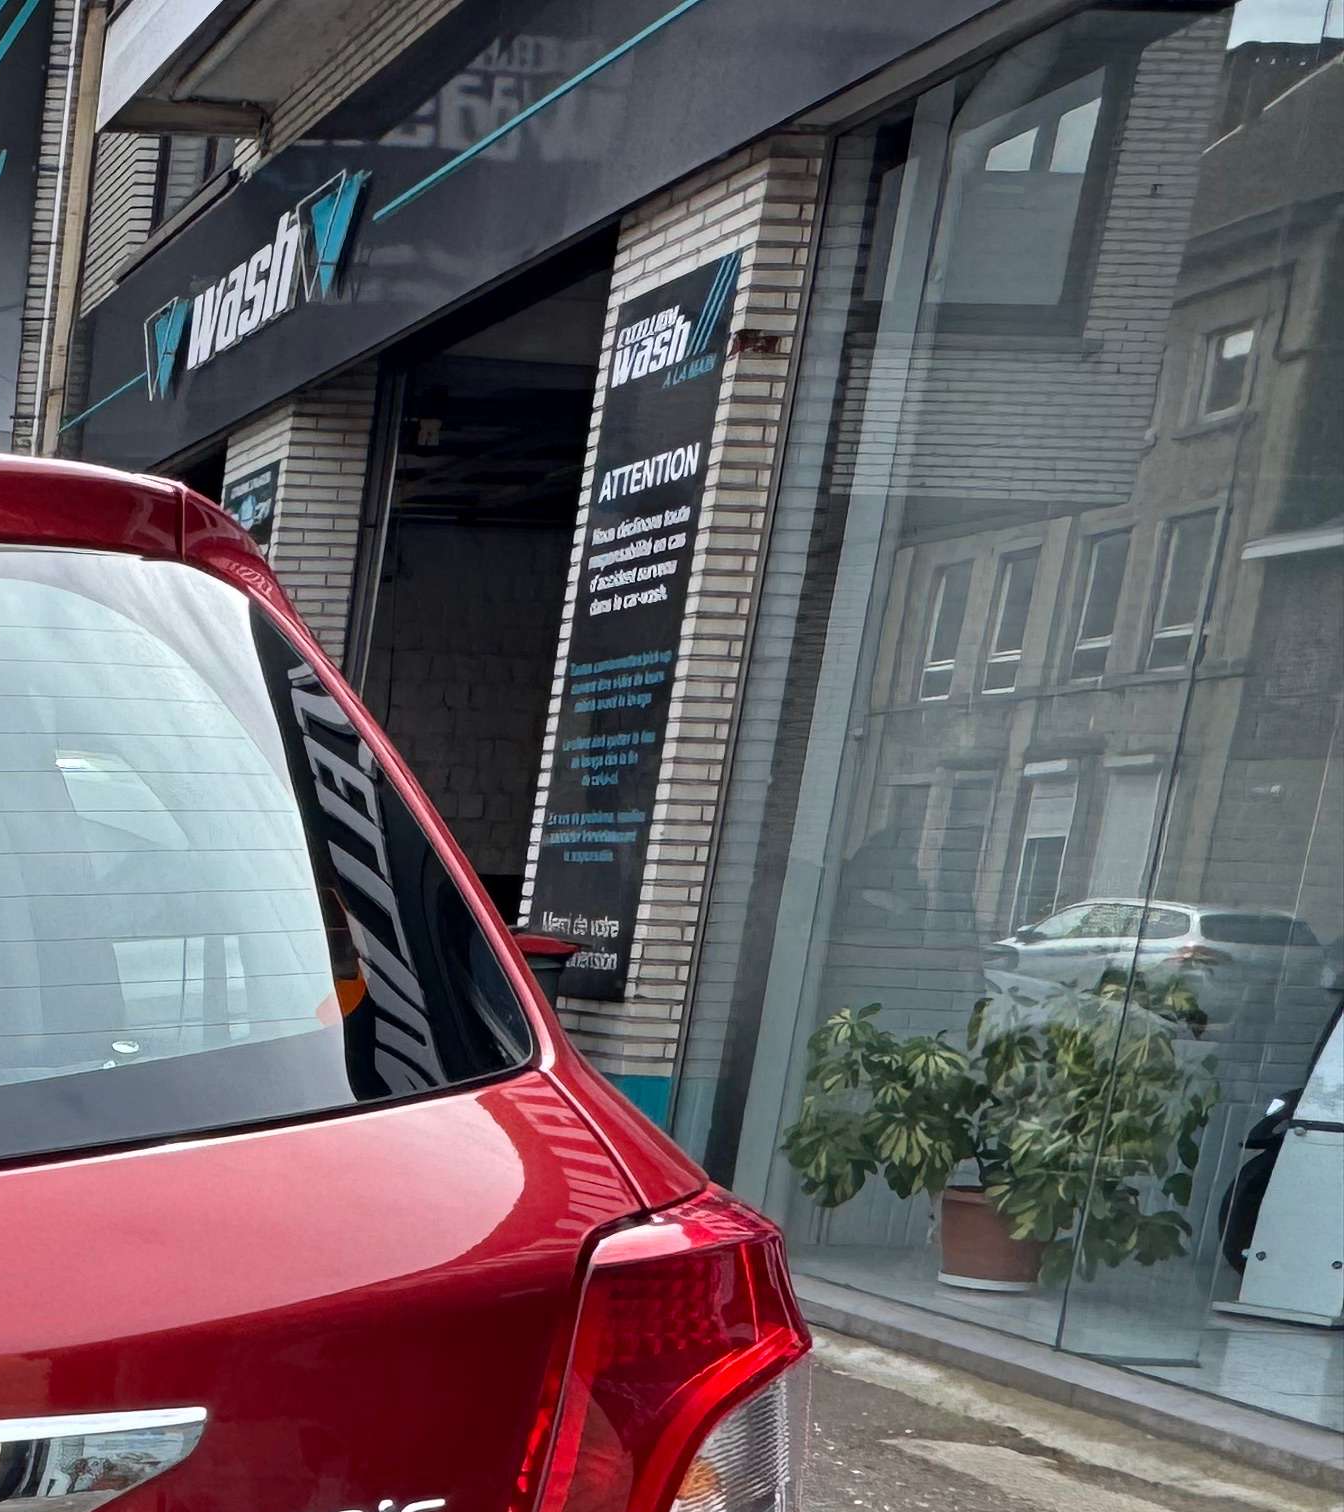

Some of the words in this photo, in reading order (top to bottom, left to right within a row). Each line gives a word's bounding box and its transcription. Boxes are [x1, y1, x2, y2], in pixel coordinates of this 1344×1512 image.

[187, 210, 303, 371] wash
[611, 314, 692, 389] wash
[597, 442, 702, 503] ATTENTION
